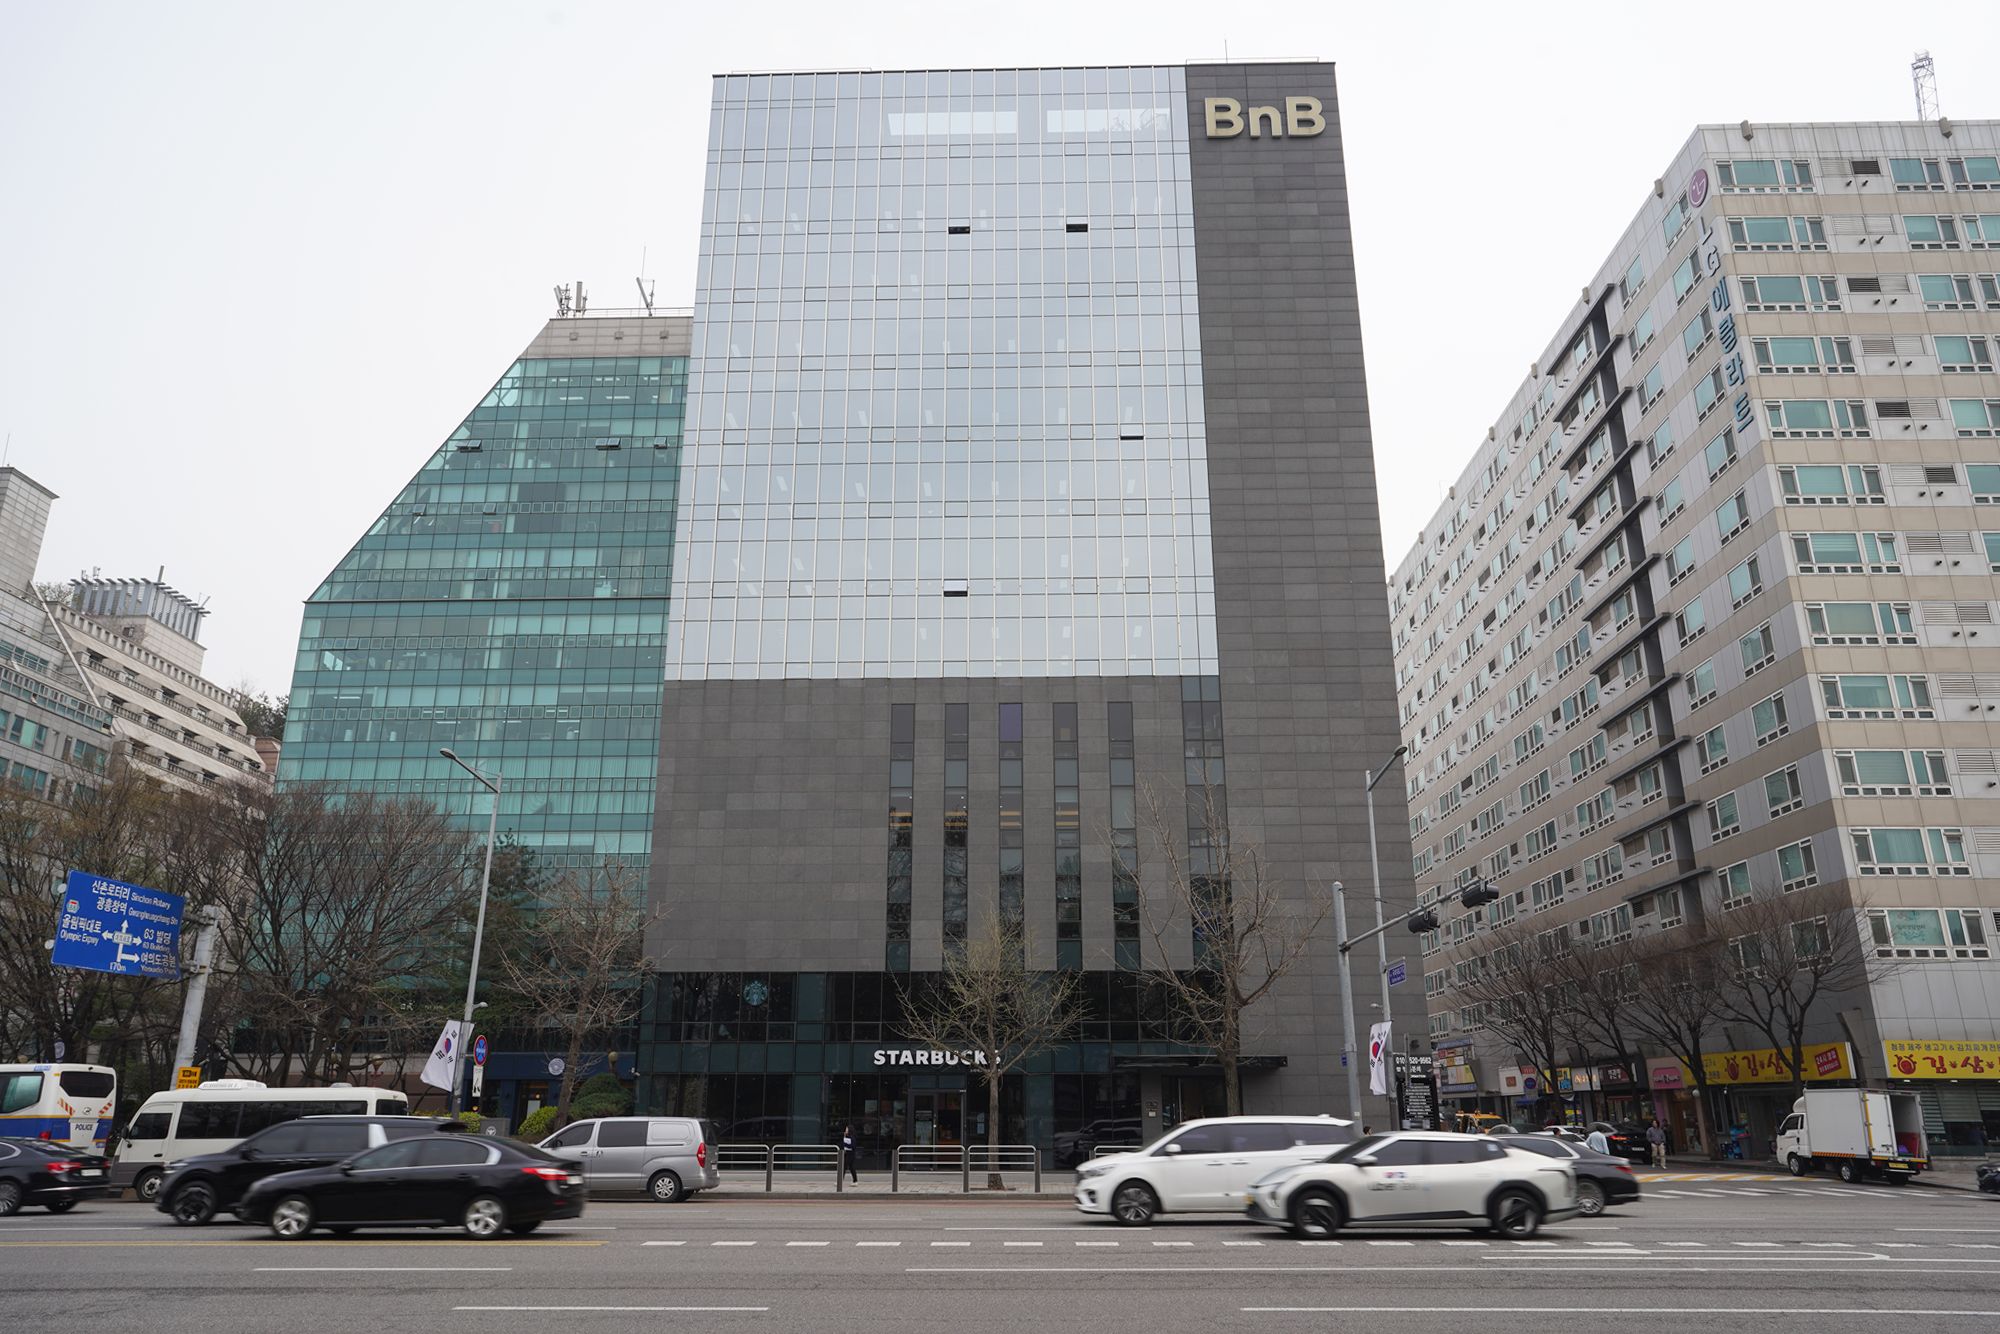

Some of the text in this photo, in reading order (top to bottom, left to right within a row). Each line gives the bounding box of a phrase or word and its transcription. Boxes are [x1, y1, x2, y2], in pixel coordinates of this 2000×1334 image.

[1205, 96, 1326, 139] BnB
[92, 880, 130, 900] 신촌로터리
[153, 897, 171, 910] Rotary
[96, 896, 128, 915] 광흥창역
[62, 914, 102, 933] 올림픽대로
[60, 929, 81, 942] Olympic
[143, 928, 154, 940] 63
[156, 930, 172, 945] 빌딩
[141, 951, 176, 968] 여의도공원
[75, 1123, 93, 1131] POLICE
